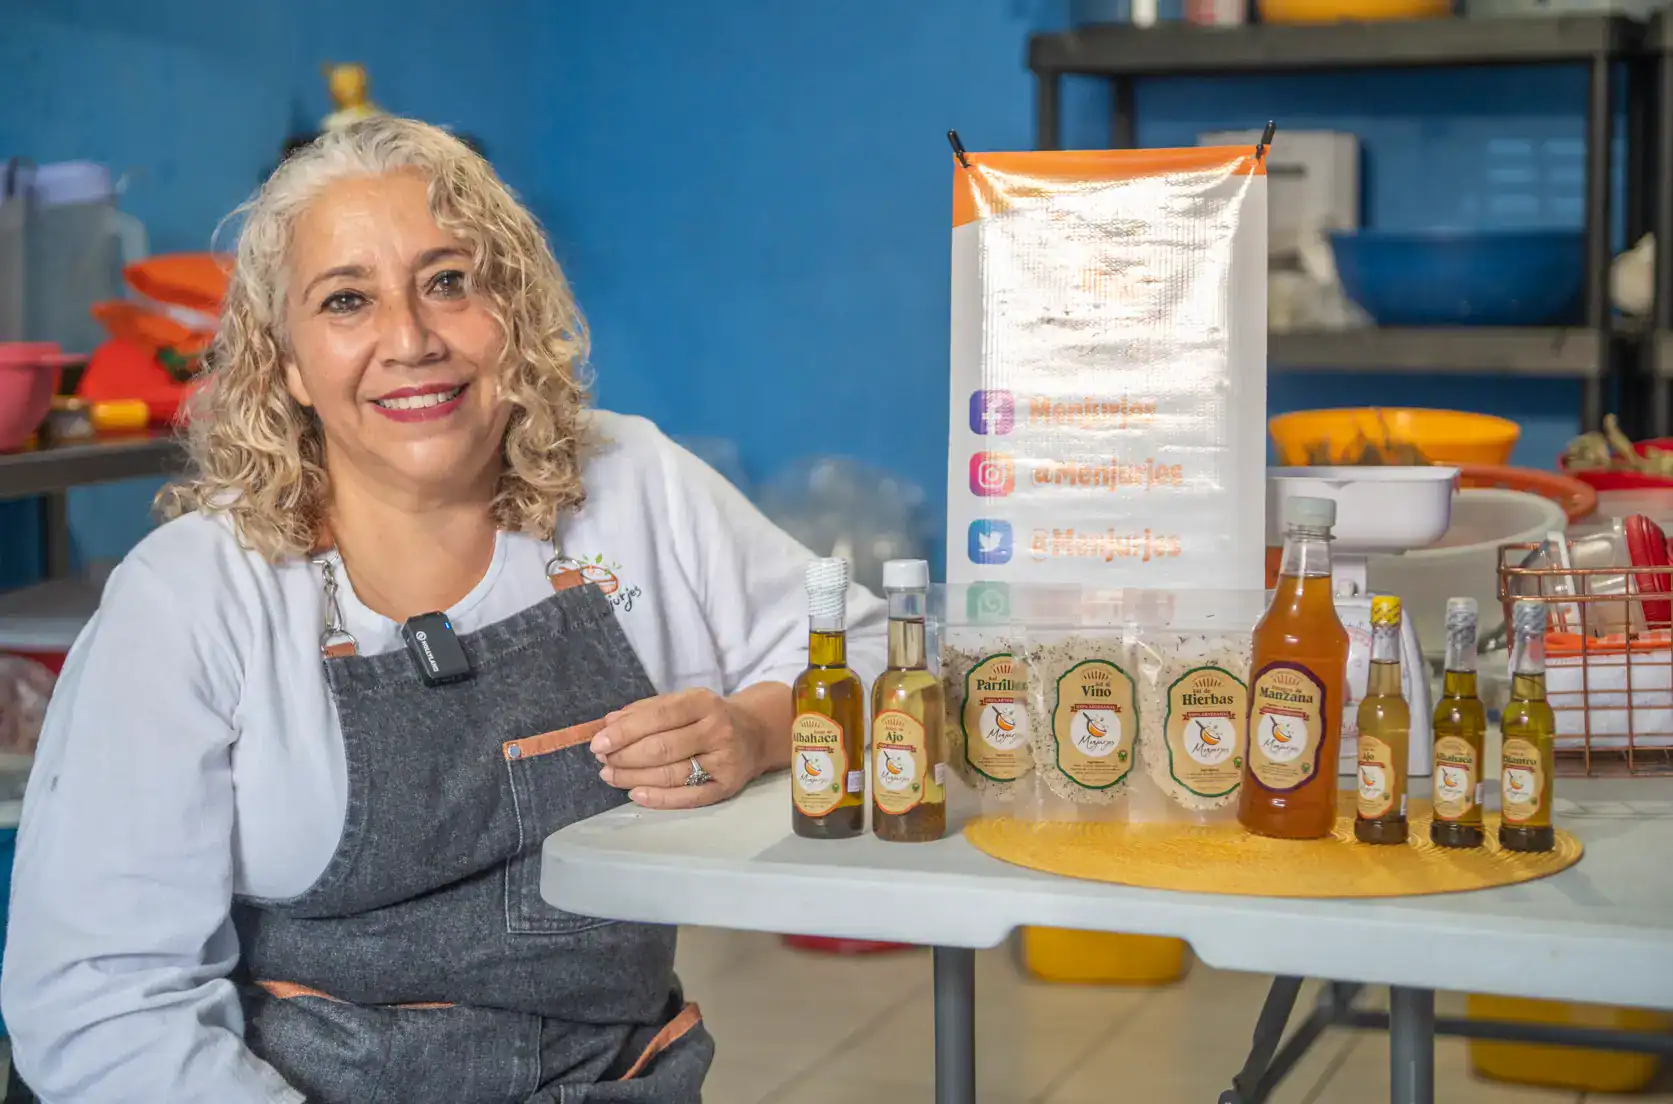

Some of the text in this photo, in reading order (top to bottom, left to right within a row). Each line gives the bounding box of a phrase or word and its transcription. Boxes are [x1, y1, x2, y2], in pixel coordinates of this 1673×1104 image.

[1031, 459, 1184, 491] @Menjurjes
[1030, 528, 1182, 562] @Menjurjes
[609, 586, 642, 612] jurjes
[421, 640, 440, 672] HOLLYLAND
[1081, 685, 1112, 697] Vino
[1182, 693, 1234, 705] Hierbas
[1259, 686, 1314, 704] Manzana
[885, 731, 904, 744] Ajo
[1363, 752, 1375, 761] Ajo
